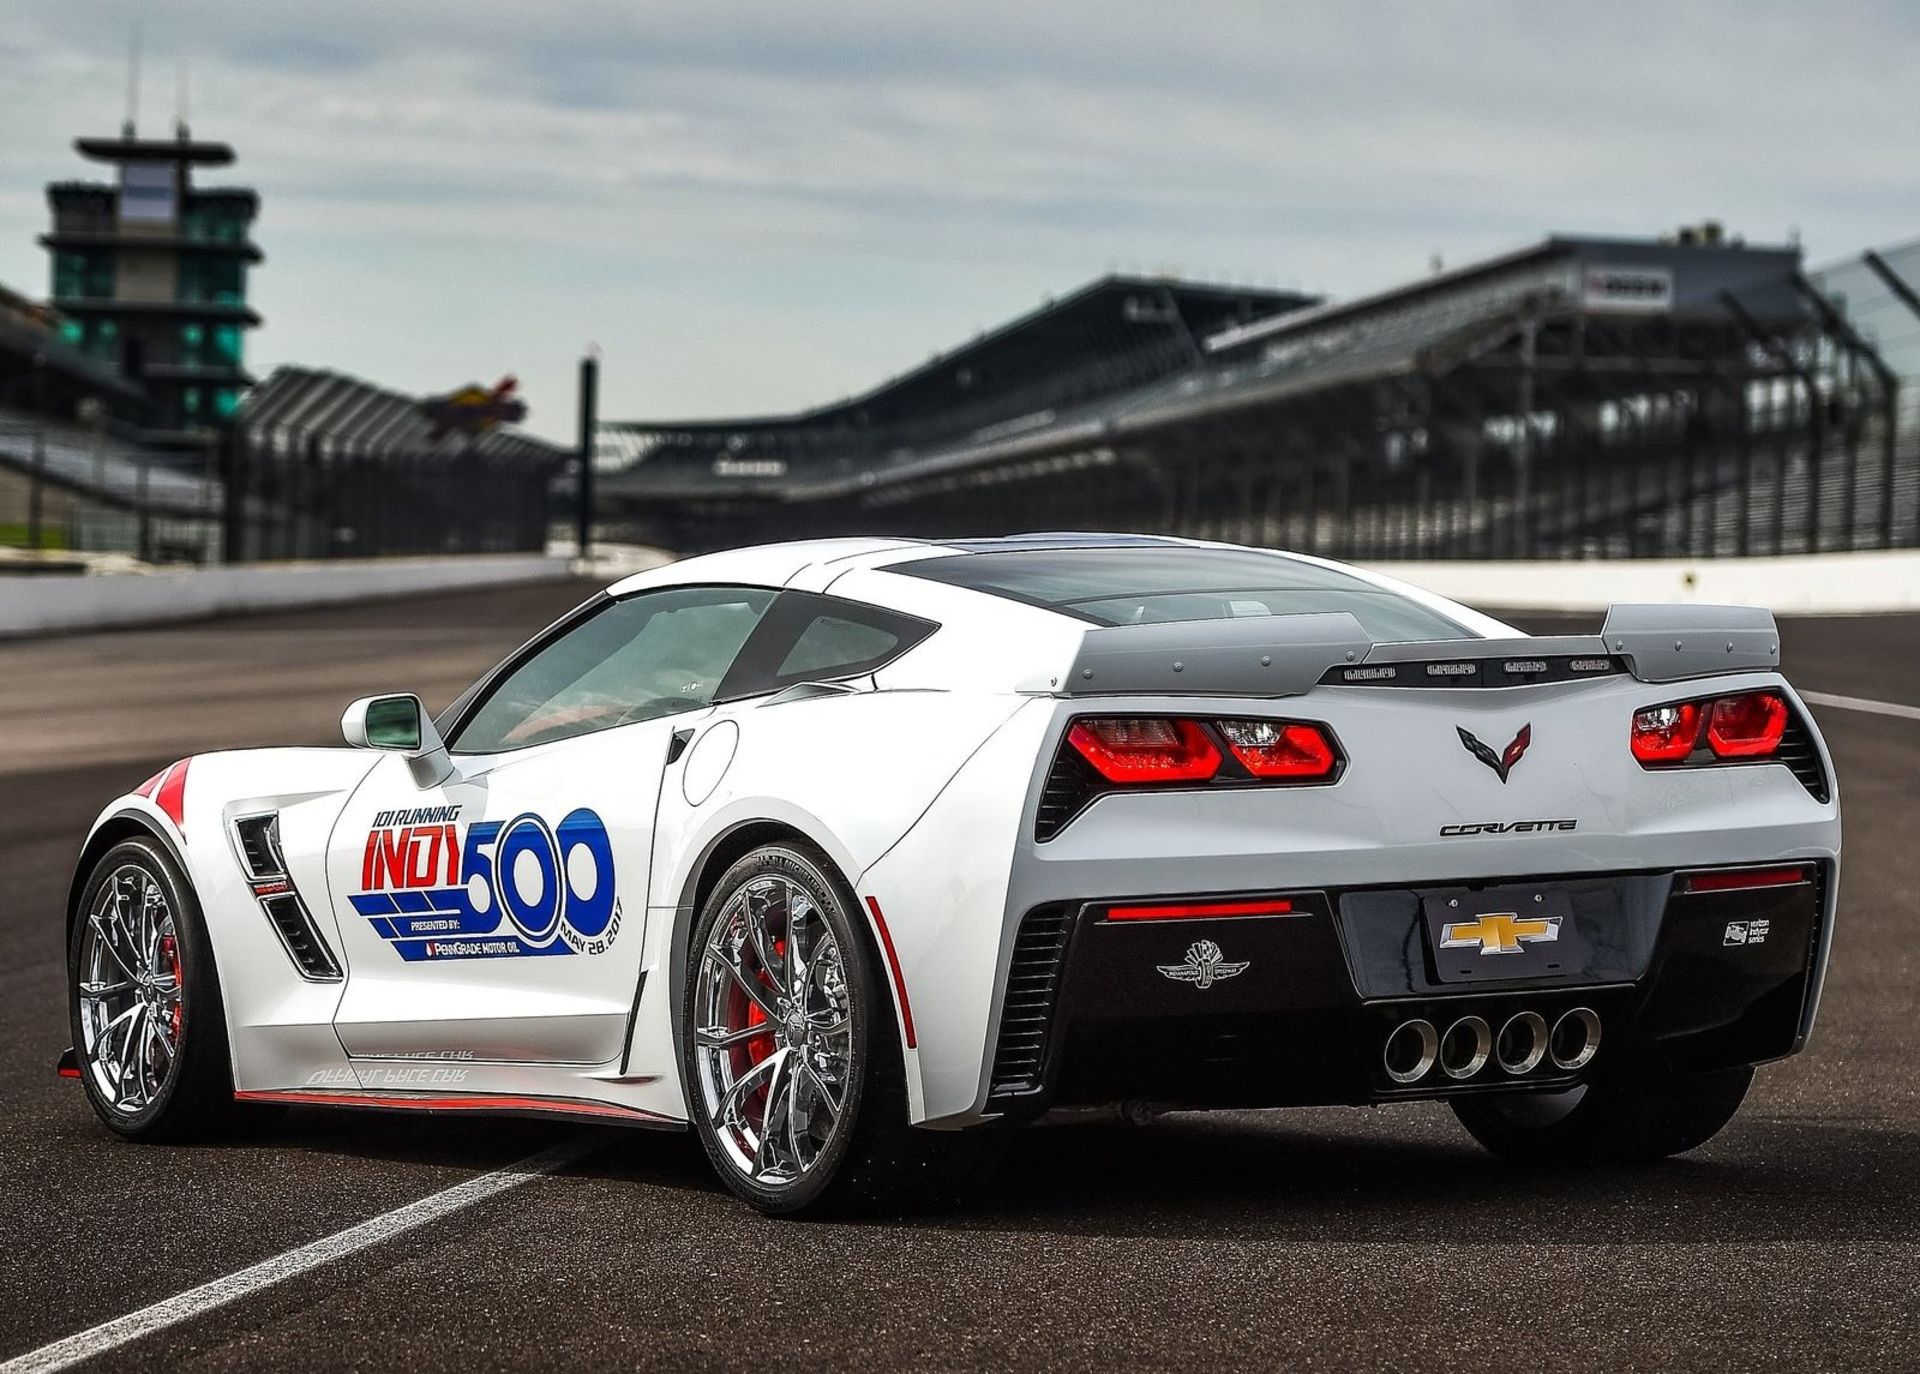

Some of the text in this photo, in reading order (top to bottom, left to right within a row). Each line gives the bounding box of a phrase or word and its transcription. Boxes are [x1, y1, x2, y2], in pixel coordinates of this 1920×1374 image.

[372, 804, 462, 828] 101 RUNNING
[1439, 819, 1578, 837] CORVETTE
[361, 806, 617, 938] INDY 500
[410, 919, 460, 932] PRESENTED BY:
[560, 920, 586, 952] MAY
[483, 942, 507, 954] MOTOR
[506, 941, 520, 953] OIL
